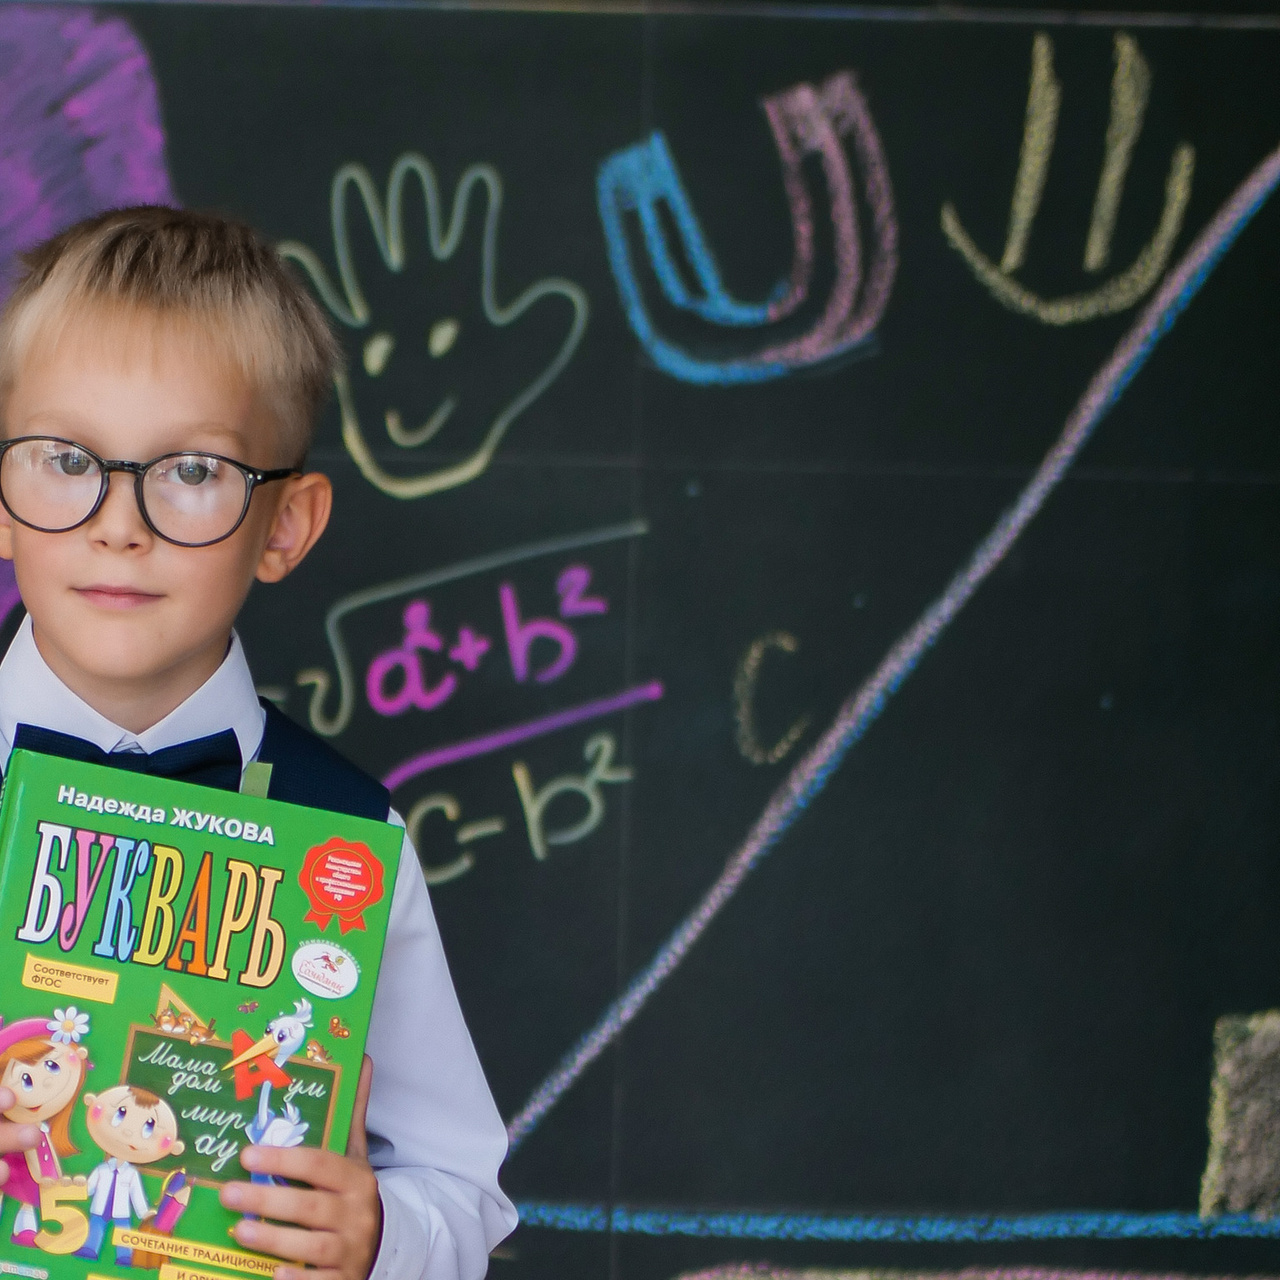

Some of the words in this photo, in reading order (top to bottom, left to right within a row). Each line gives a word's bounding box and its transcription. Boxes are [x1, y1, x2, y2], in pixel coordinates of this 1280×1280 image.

[57, 785, 166, 824] Надежда
[170, 807, 276, 846] ЖУКОВА
[16, 819, 287, 989] БУКВАРЬ
[31, 974, 62, 989] ФГОС
[33, 963, 110, 987] Соответствует
[138, 1042, 218, 1076] Мама
[167, 1071, 223, 1096] дом
[283, 1078, 327, 1103] ум
[181, 1105, 246, 1139] мир
[194, 1134, 239, 1173] ау
[33, 1182, 89, 1255] 5
[121, 1233, 190, 1257] СОЧЕТАНИЕ
[176, 1271, 186, 1280] И
